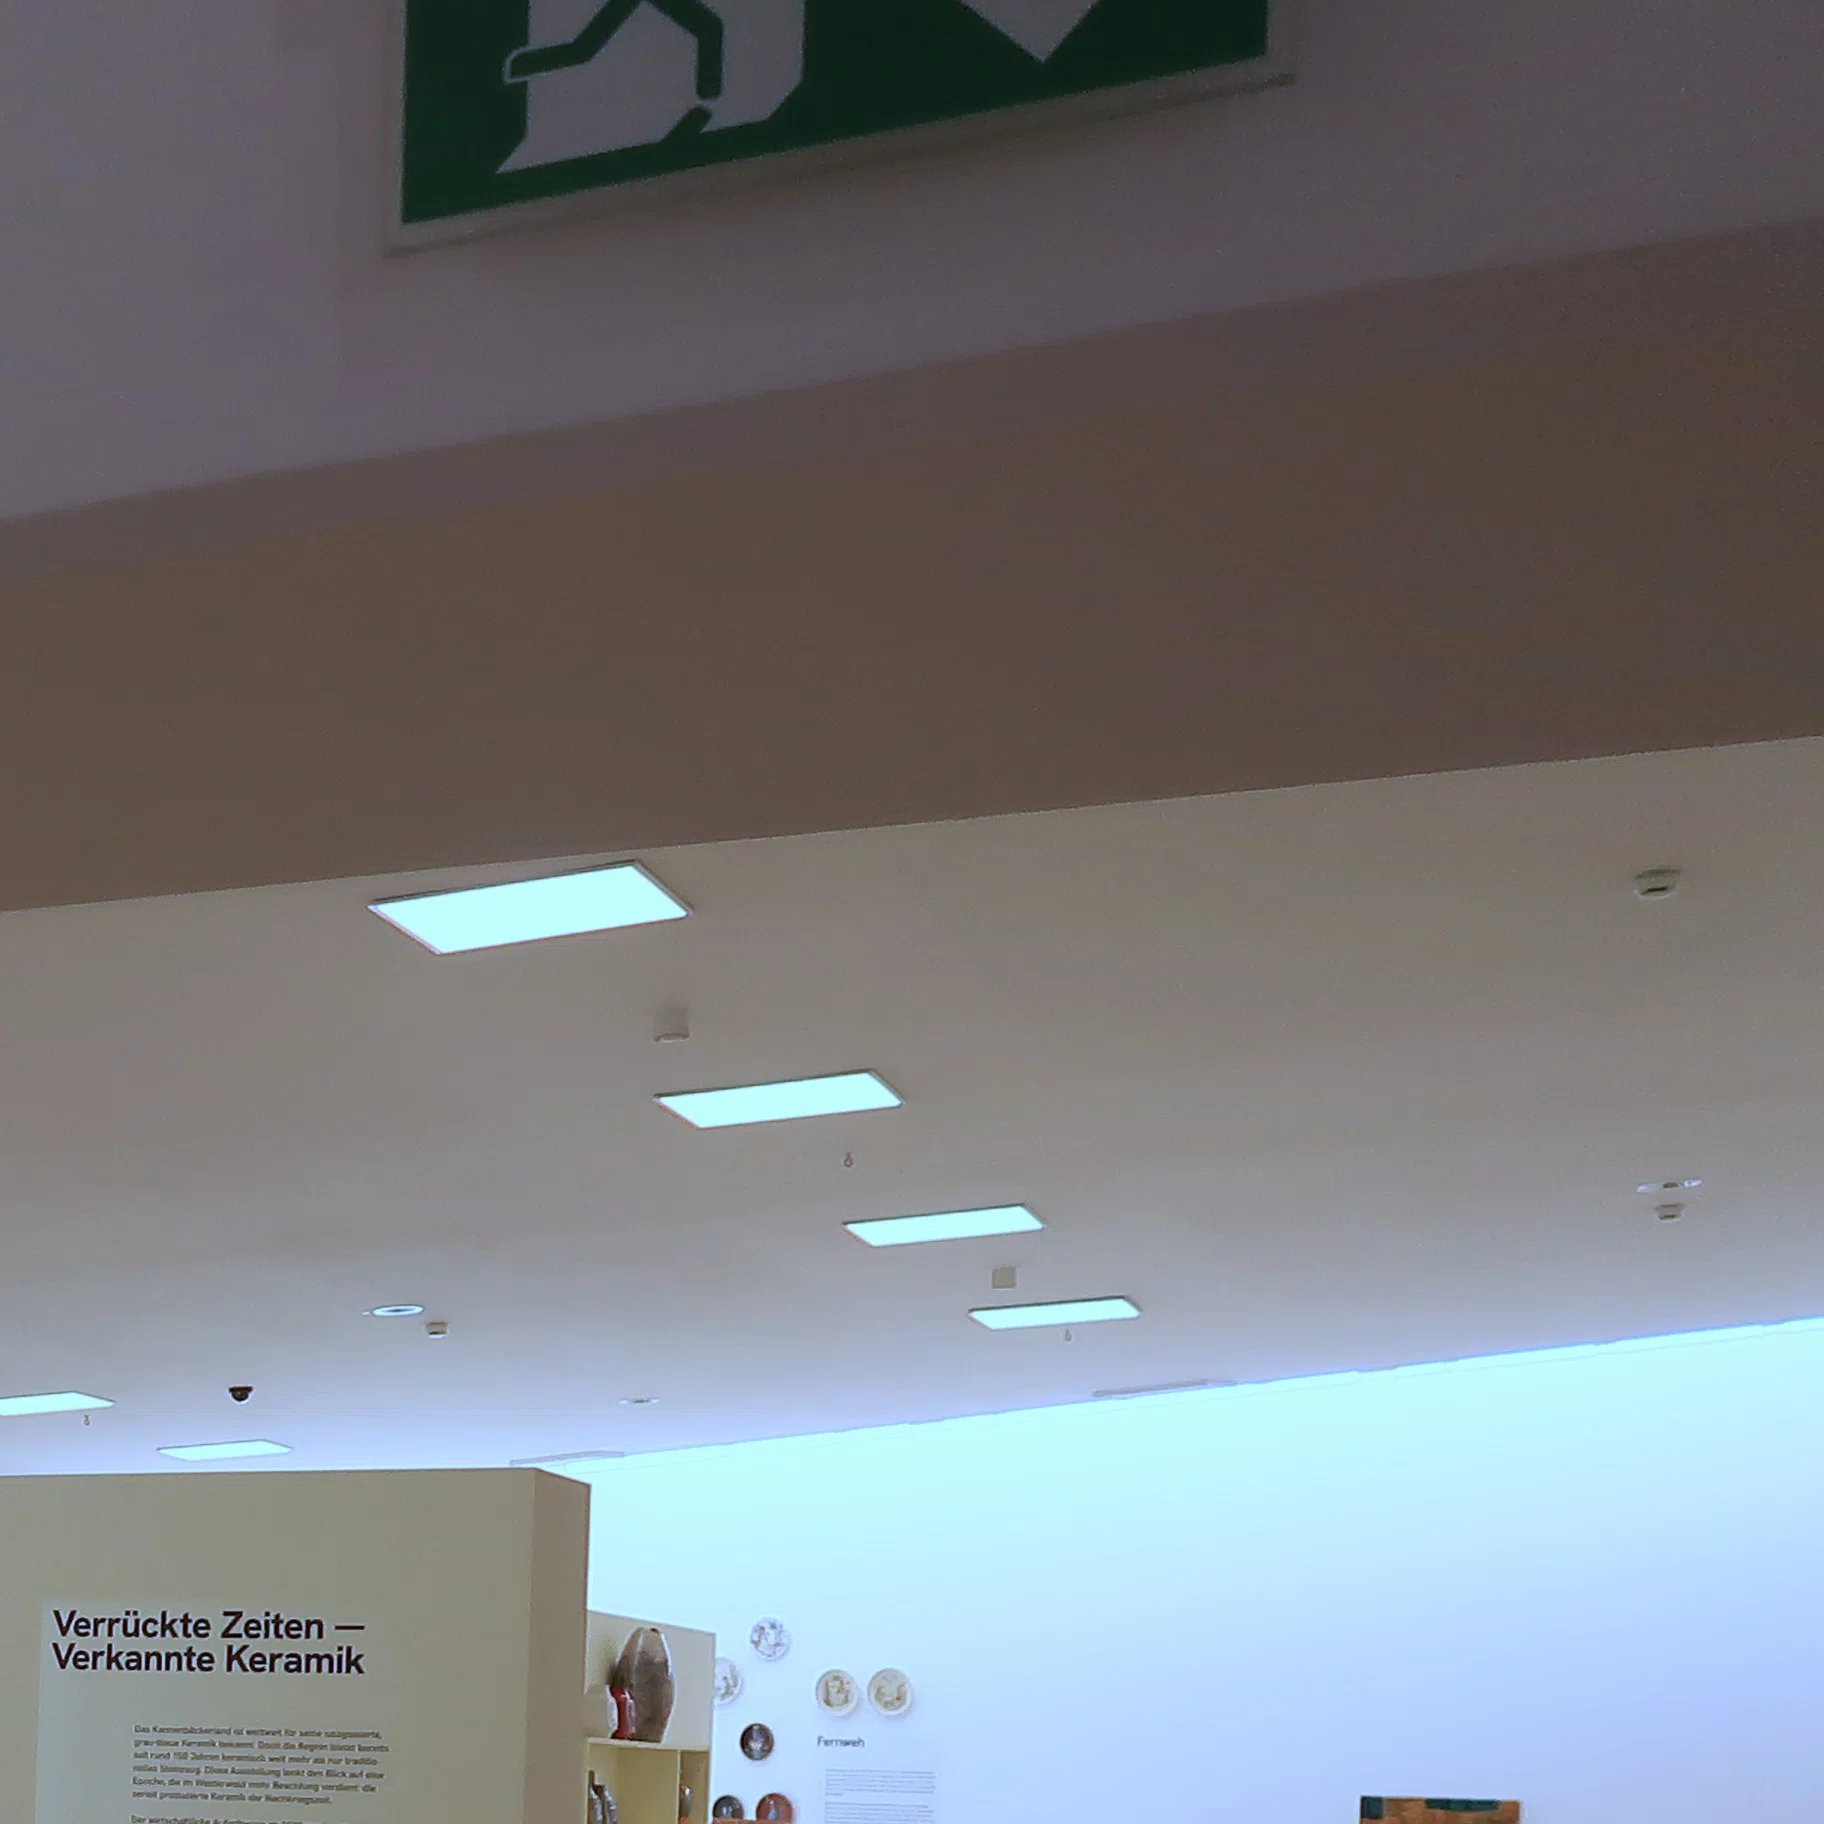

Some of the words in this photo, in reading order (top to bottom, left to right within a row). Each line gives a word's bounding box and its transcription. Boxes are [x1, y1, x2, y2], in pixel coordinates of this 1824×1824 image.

[52, 1609, 212, 1639] Verrückte
[220, 1610, 324, 1640] Zeiten
[51, 1642, 216, 1673] Verkannte
[226, 1644, 365, 1675] Keramik
